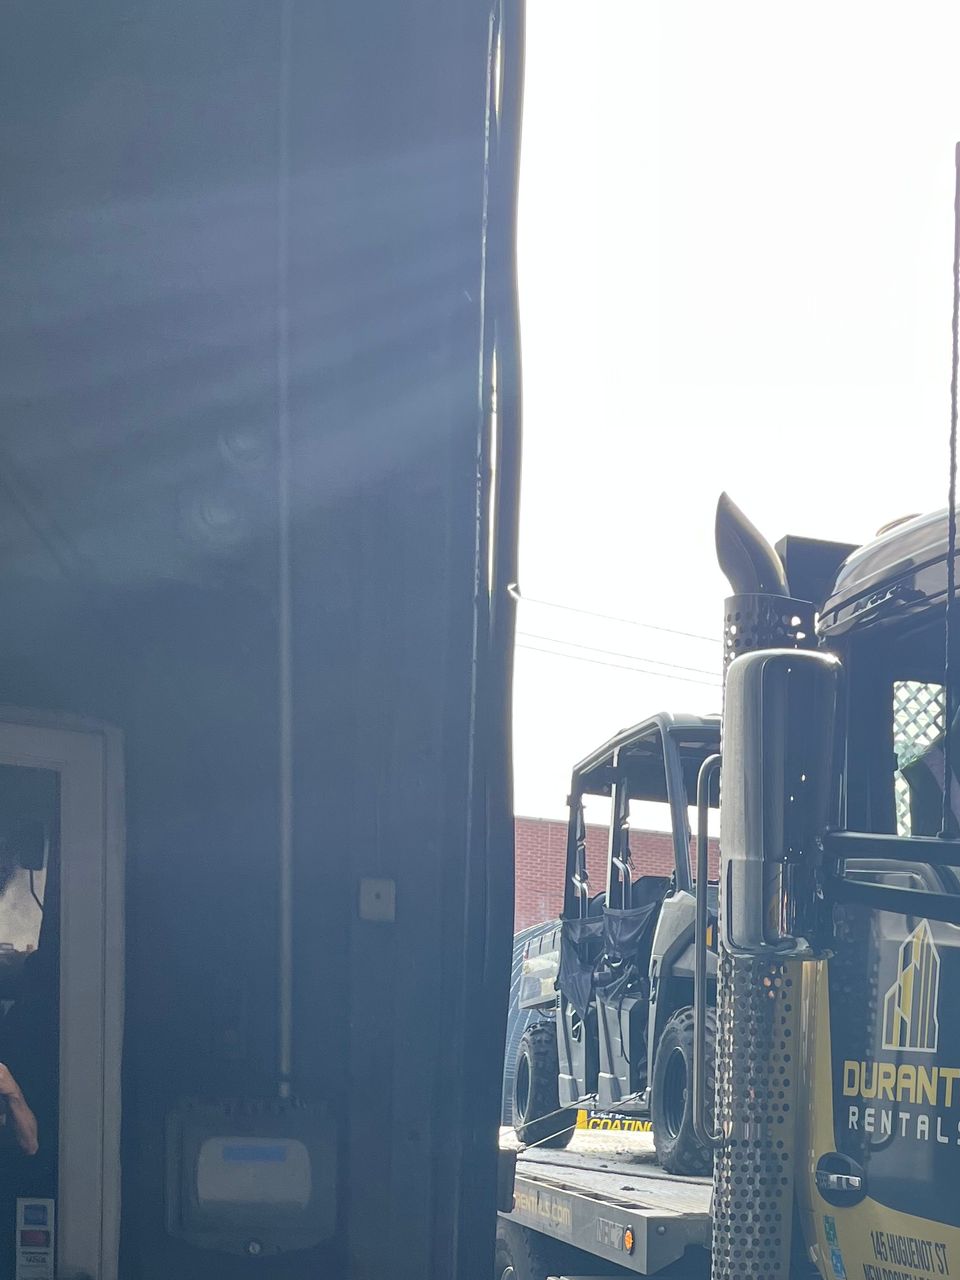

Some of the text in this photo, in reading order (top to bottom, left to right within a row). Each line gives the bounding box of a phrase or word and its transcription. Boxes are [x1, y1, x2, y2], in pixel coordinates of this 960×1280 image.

[870, 1231, 949, 1275] 145 HUGUENOT ST
